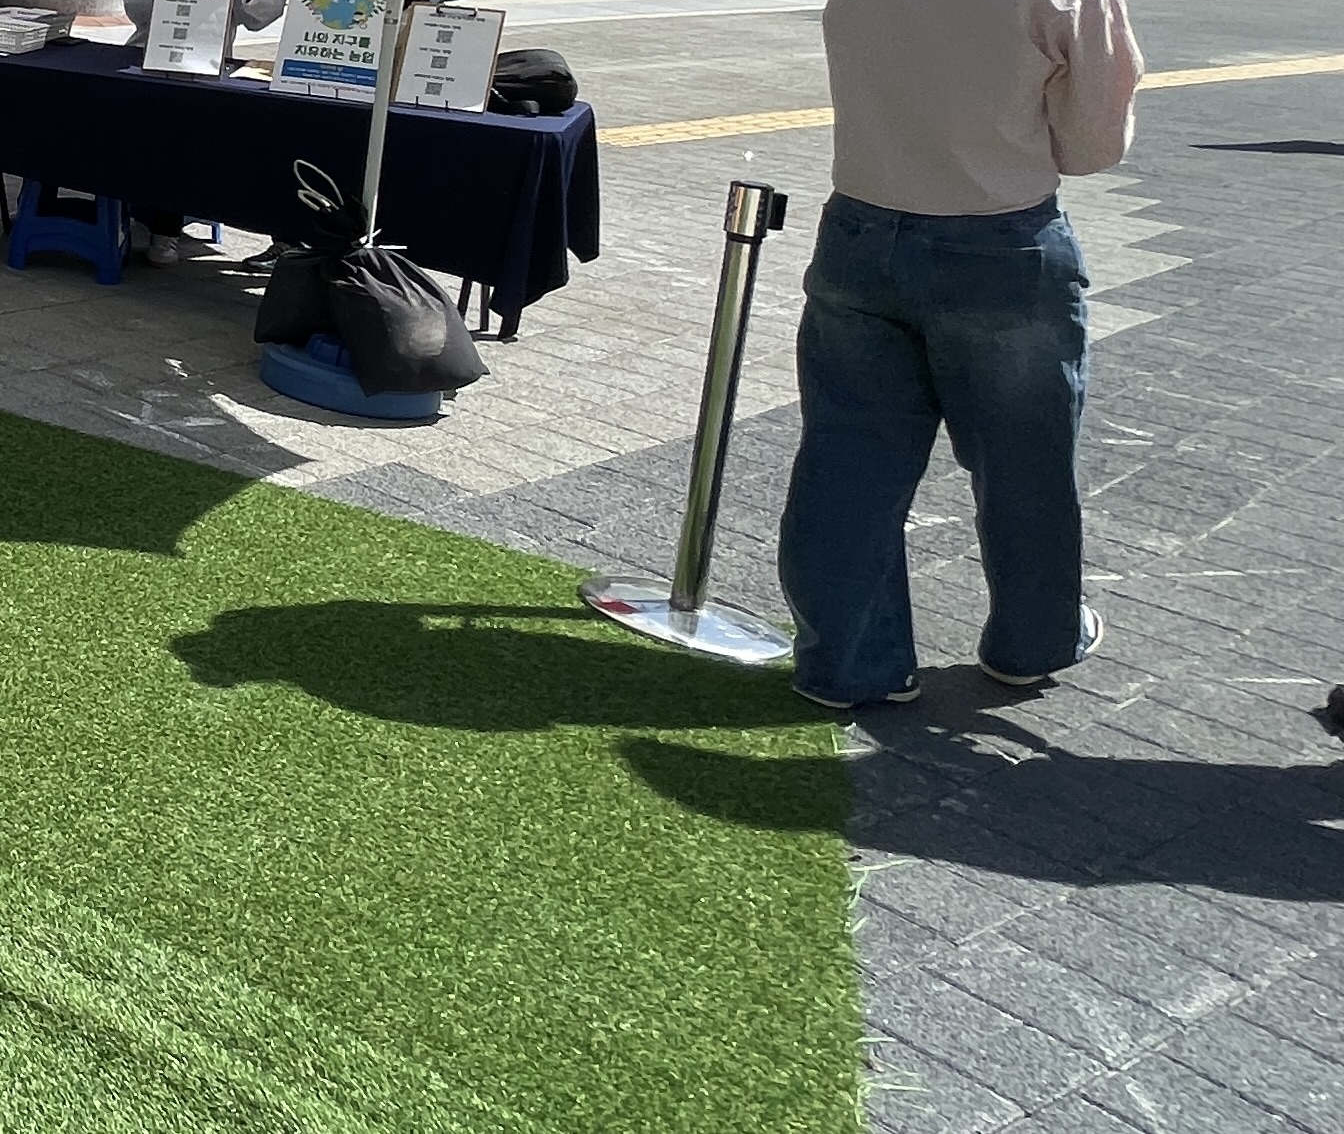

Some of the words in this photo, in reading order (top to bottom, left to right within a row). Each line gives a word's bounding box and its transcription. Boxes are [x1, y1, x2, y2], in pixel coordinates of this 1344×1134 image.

[303, 31, 329, 43] 나와
[332, 33, 371, 48] 지구를
[294, 44, 344, 60] 치유하는
[349, 50, 375, 64] 농업
